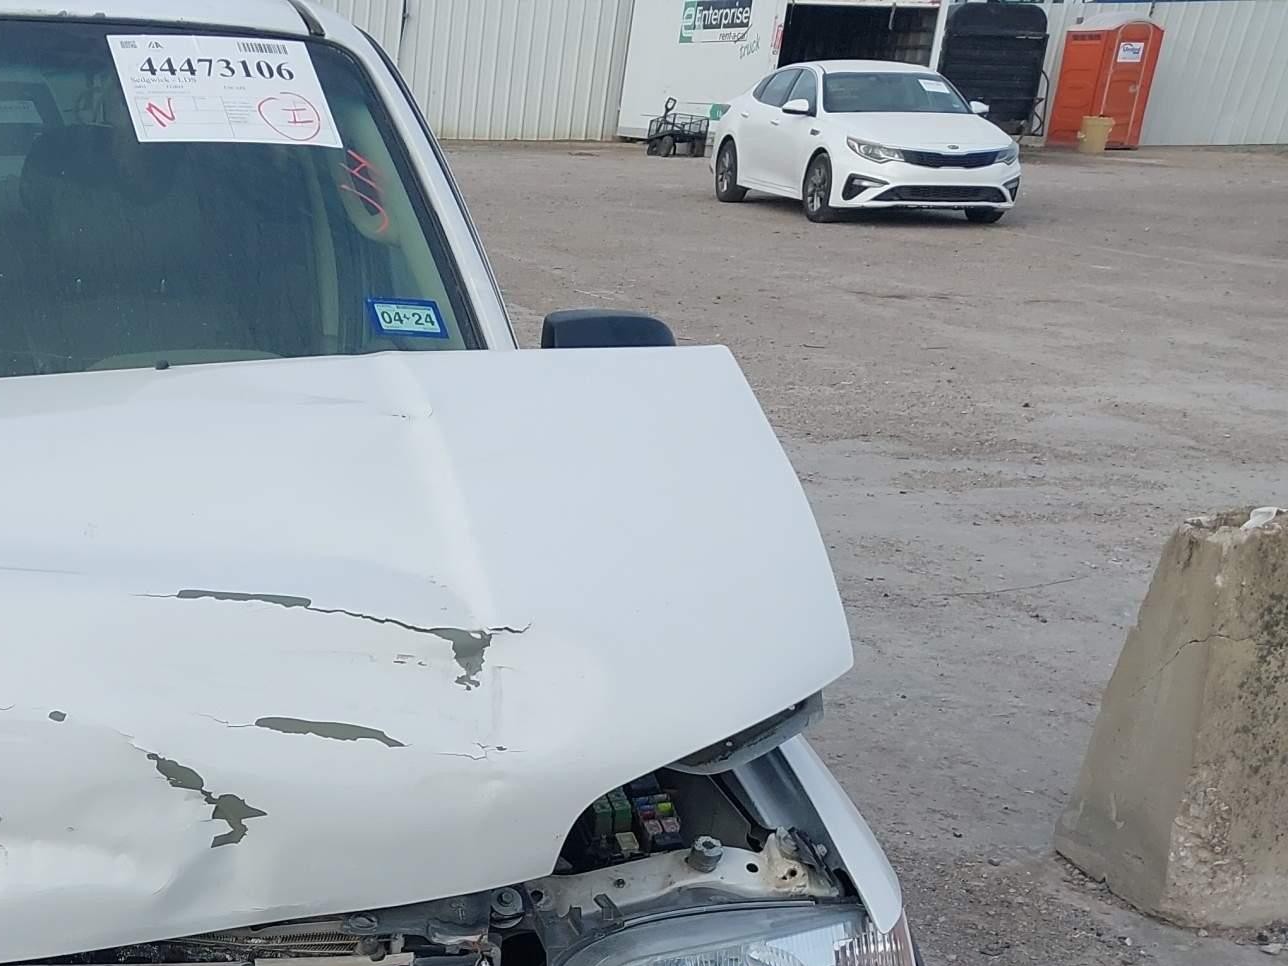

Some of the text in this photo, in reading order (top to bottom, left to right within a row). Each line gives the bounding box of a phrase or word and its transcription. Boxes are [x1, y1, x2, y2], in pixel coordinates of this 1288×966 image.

[695, 1, 751, 30] Enterprise
[140, 57, 294, 80] 44473106
[380, 311, 435, 326] 04 24
